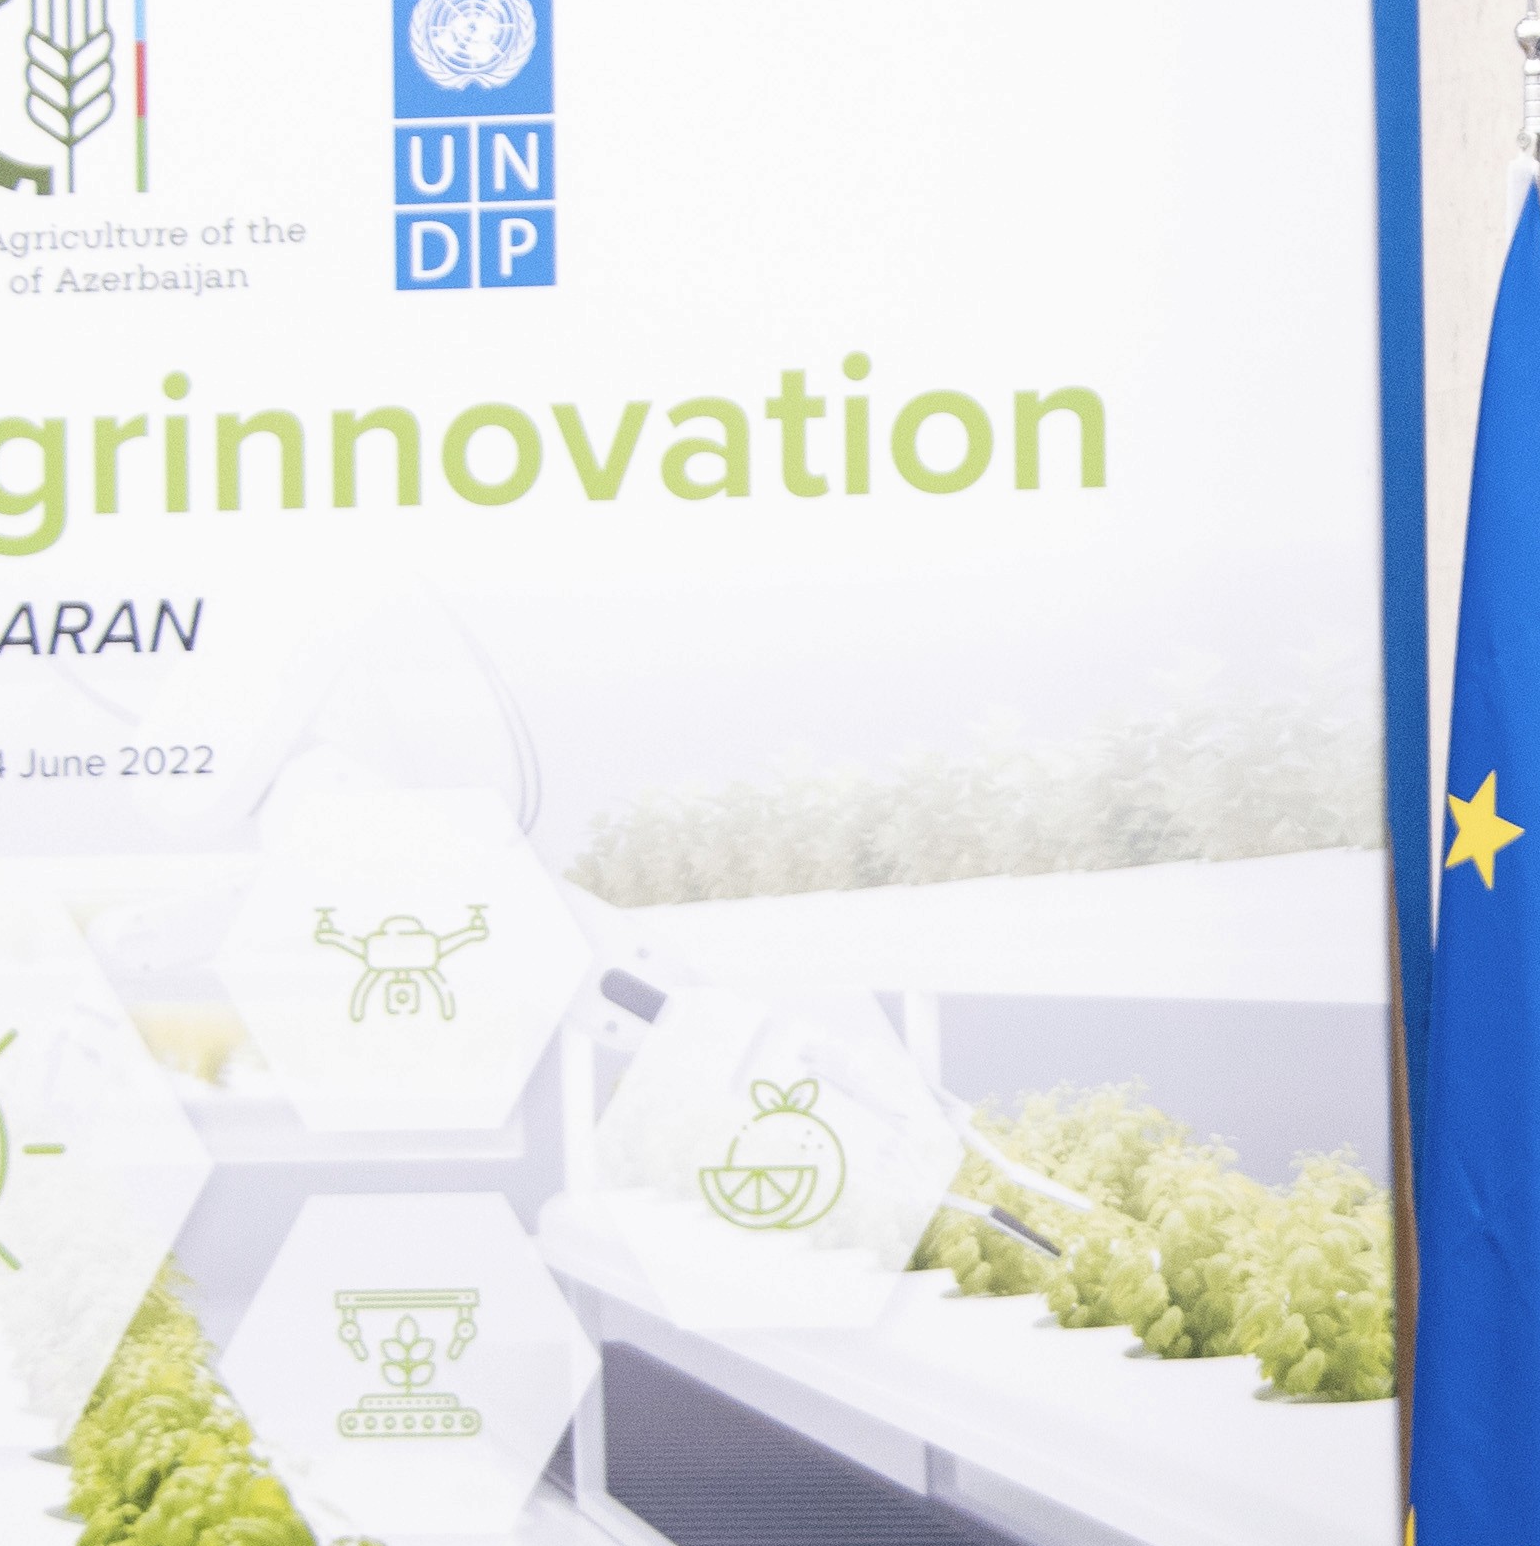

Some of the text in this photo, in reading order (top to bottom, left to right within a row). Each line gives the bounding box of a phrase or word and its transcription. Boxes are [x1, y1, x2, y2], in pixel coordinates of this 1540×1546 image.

[198, 216, 238, 248] of
[244, 215, 308, 247] the
[7, 265, 45, 298] of
[52, 262, 251, 299] Azerbaijan
[16, 747, 109, 783] June
[116, 742, 216, 781] 2022
